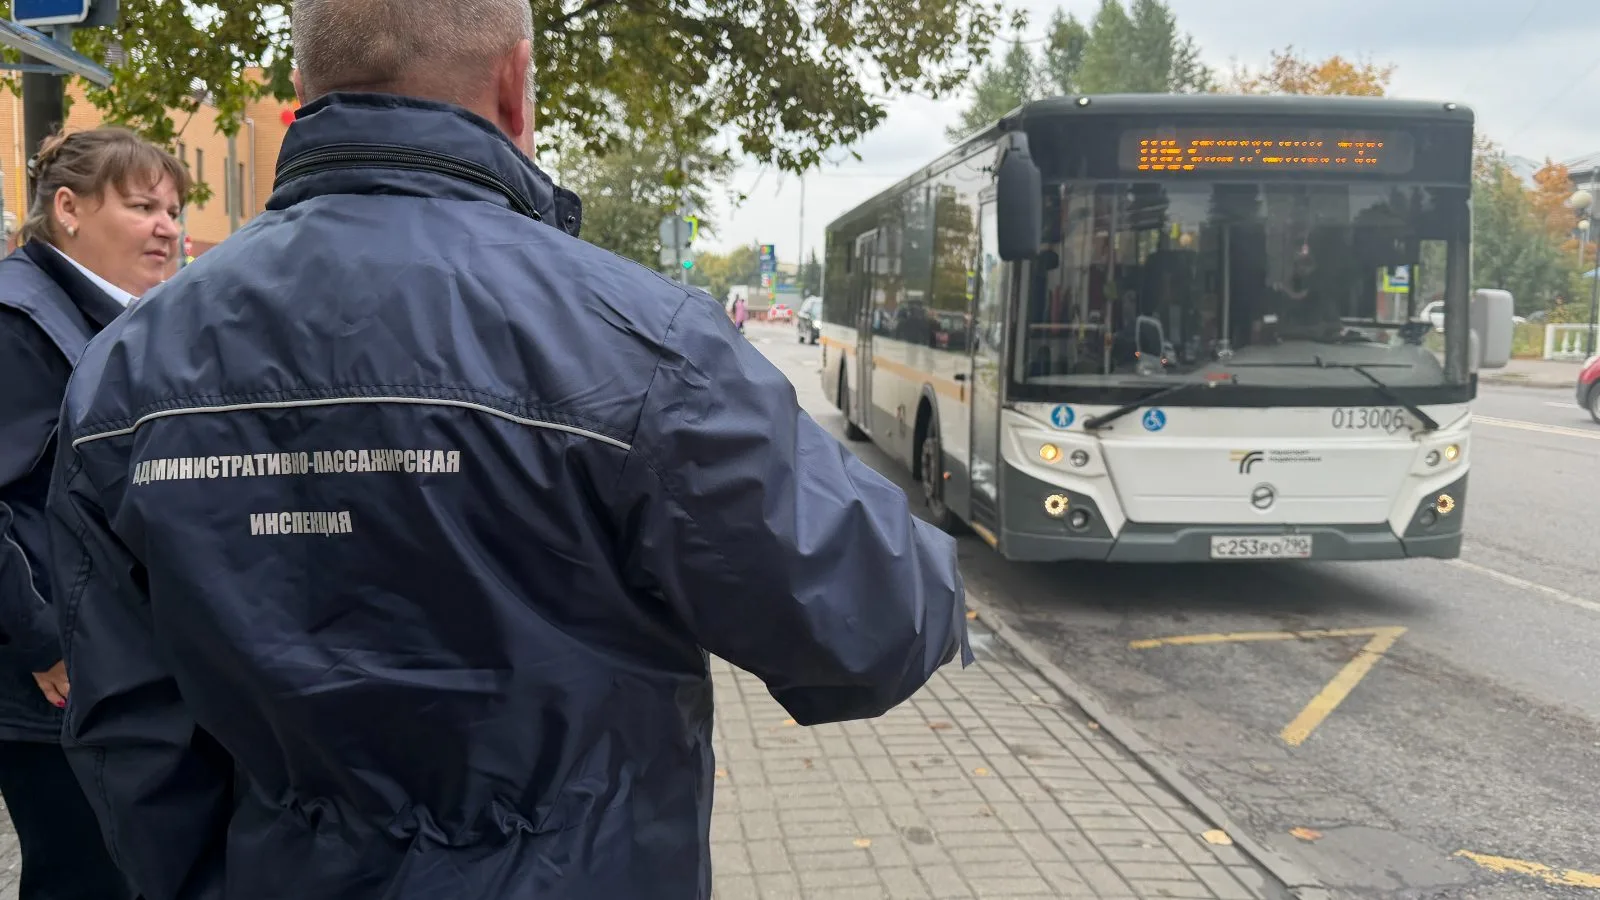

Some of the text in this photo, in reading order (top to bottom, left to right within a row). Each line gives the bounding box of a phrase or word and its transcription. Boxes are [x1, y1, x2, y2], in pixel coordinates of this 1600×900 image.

[1331, 408, 1404, 429] 013006
[132, 450, 461, 486] АДМИНИСТРАТИВНО-ПАССАЖИРСКАЯ
[250, 511, 353, 537] ИНСПЕКЦИЯ
